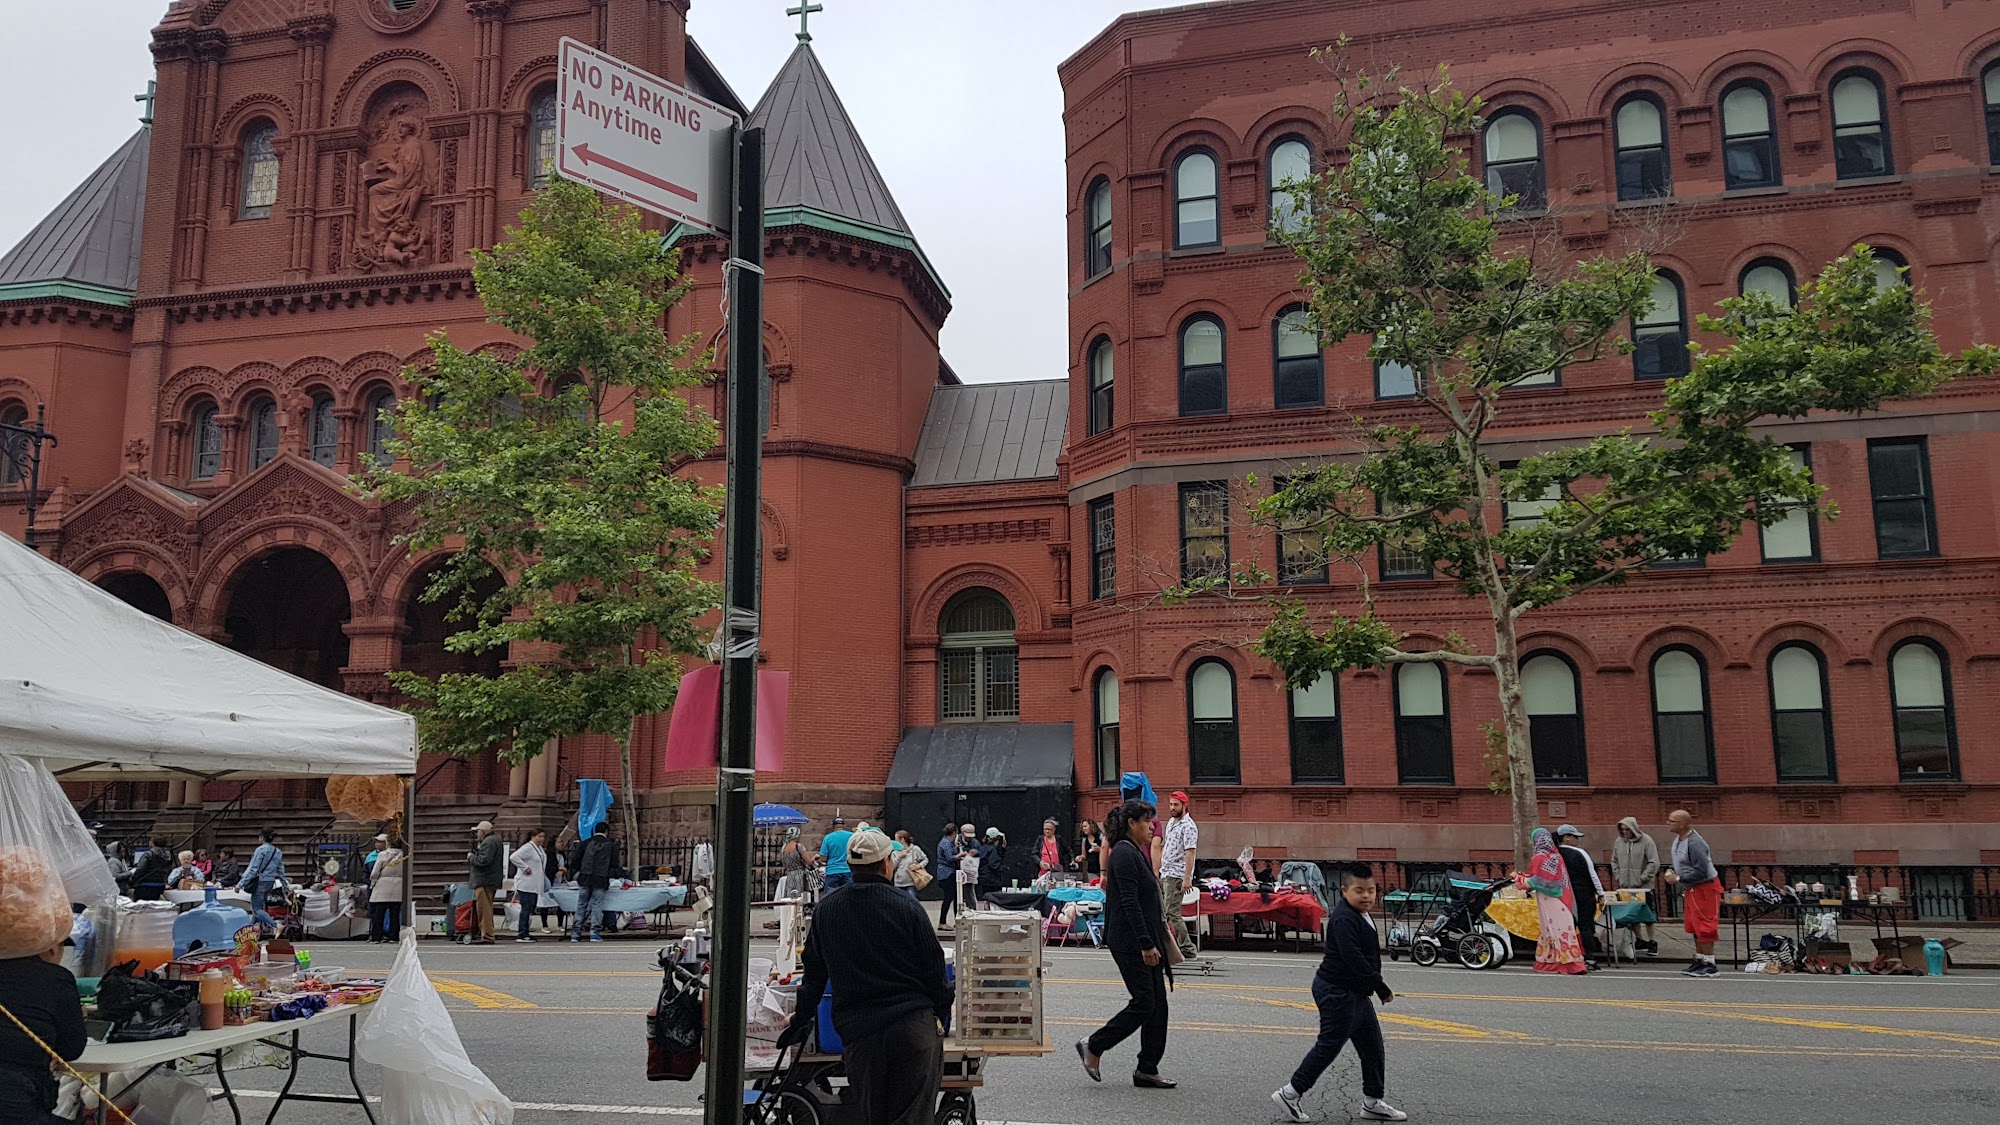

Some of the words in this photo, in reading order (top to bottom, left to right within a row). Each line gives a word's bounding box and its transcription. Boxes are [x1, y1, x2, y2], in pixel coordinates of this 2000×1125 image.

[571, 90, 662, 145] Anytime
[572, 57, 602, 89] NO
[611, 74, 701, 132] PARKING
[747, 1025, 771, 1034] THANK
[773, 1024, 786, 1032] YO
